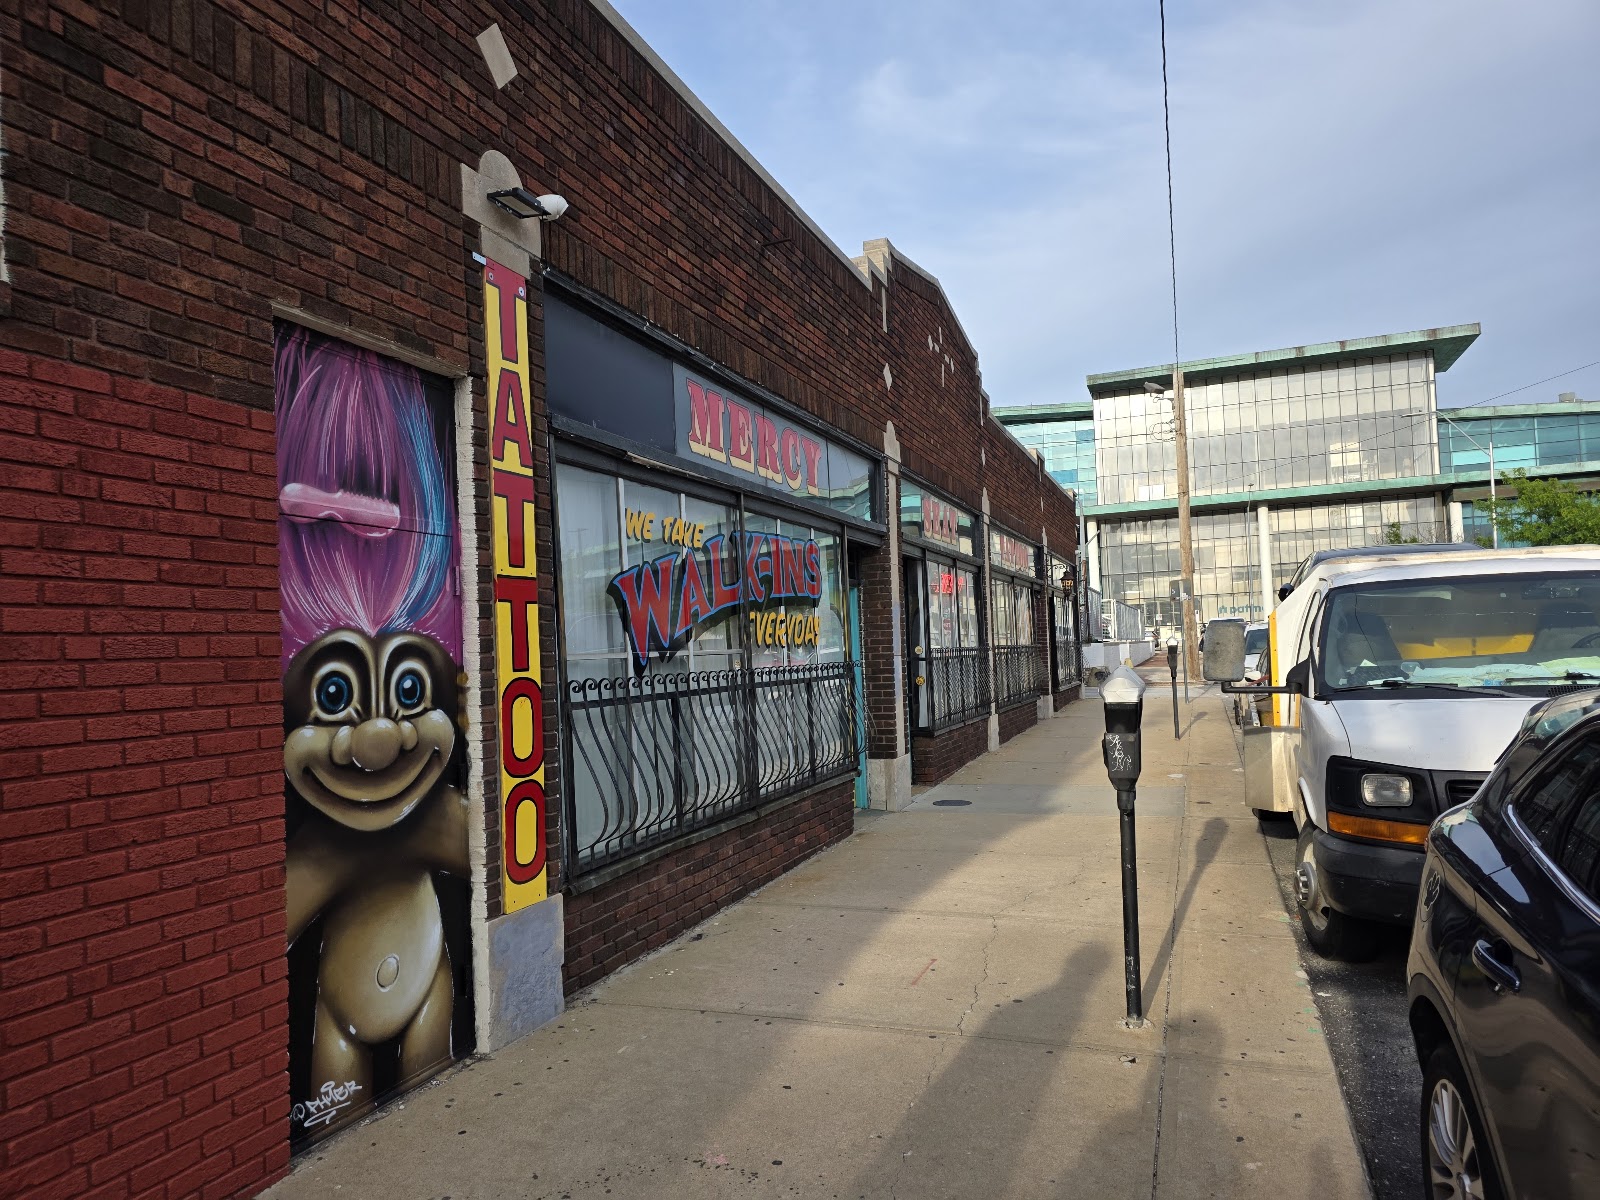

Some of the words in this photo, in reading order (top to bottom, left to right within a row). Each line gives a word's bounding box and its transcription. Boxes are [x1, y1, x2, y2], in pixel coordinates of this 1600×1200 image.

[686, 378, 822, 496] MERCY
[485, 257, 547, 885] TATTOO
[625, 507, 655, 541] WE
[662, 516, 706, 549] TAKE
[608, 530, 822, 672] WALK-INS
